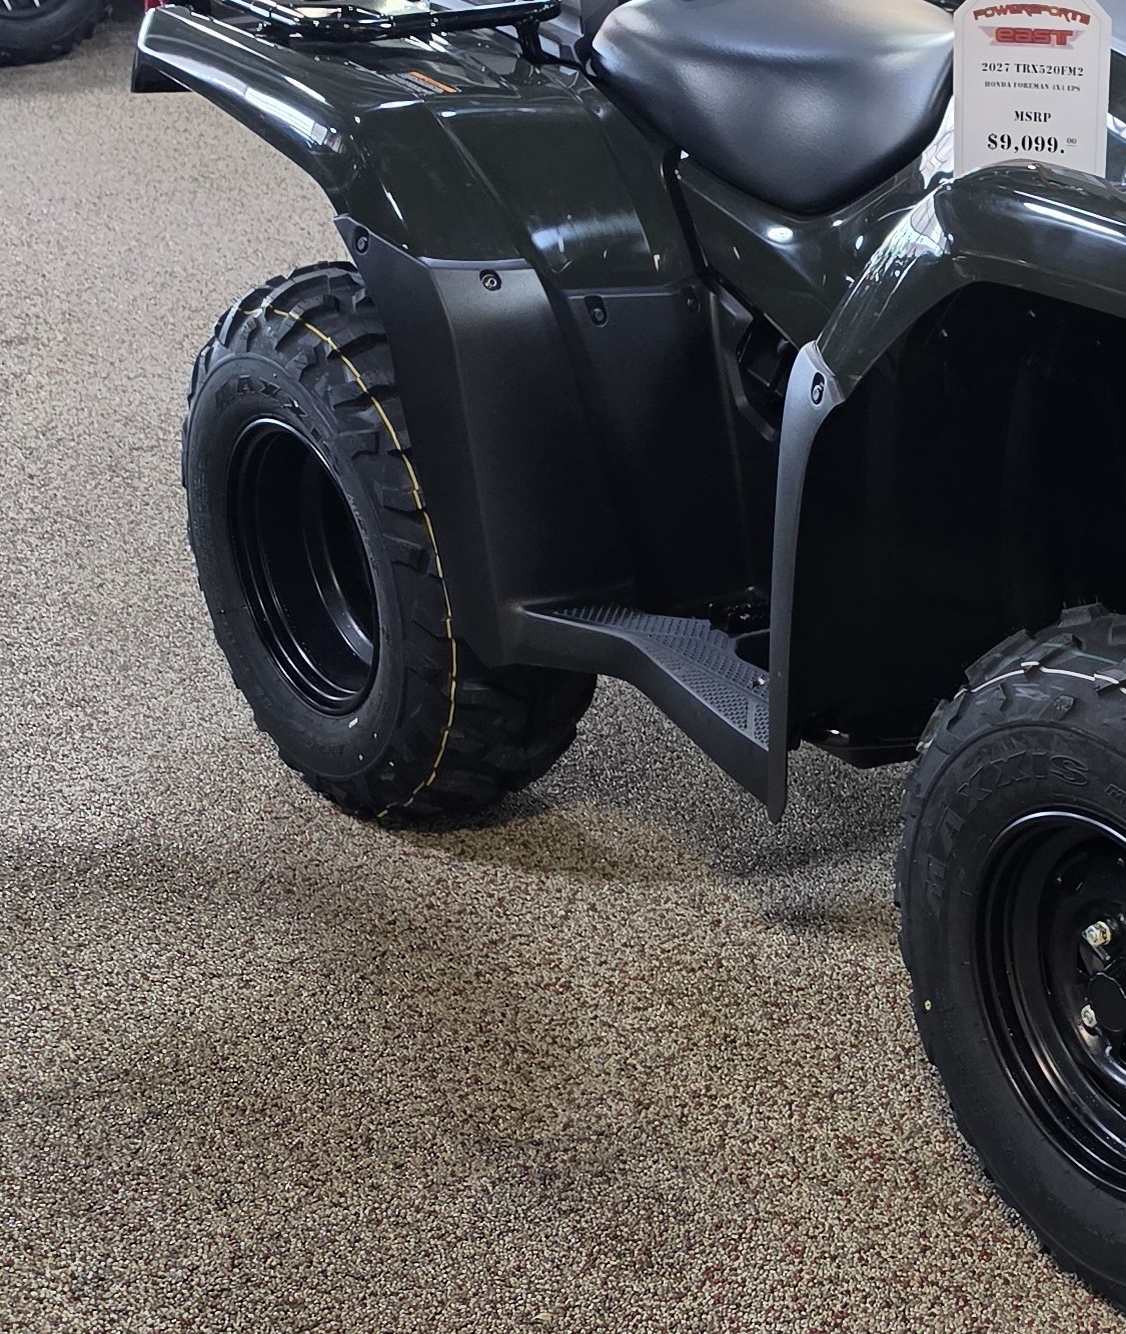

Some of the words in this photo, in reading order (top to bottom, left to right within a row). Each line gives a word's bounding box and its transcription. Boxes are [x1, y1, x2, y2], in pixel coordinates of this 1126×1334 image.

[973, 3, 1091, 25] POWERSPORTS
[981, 62, 1010, 72] 2027
[1014, 63, 1084, 77] TRX520FM2
[1014, 110, 1052, 123] MSRP
